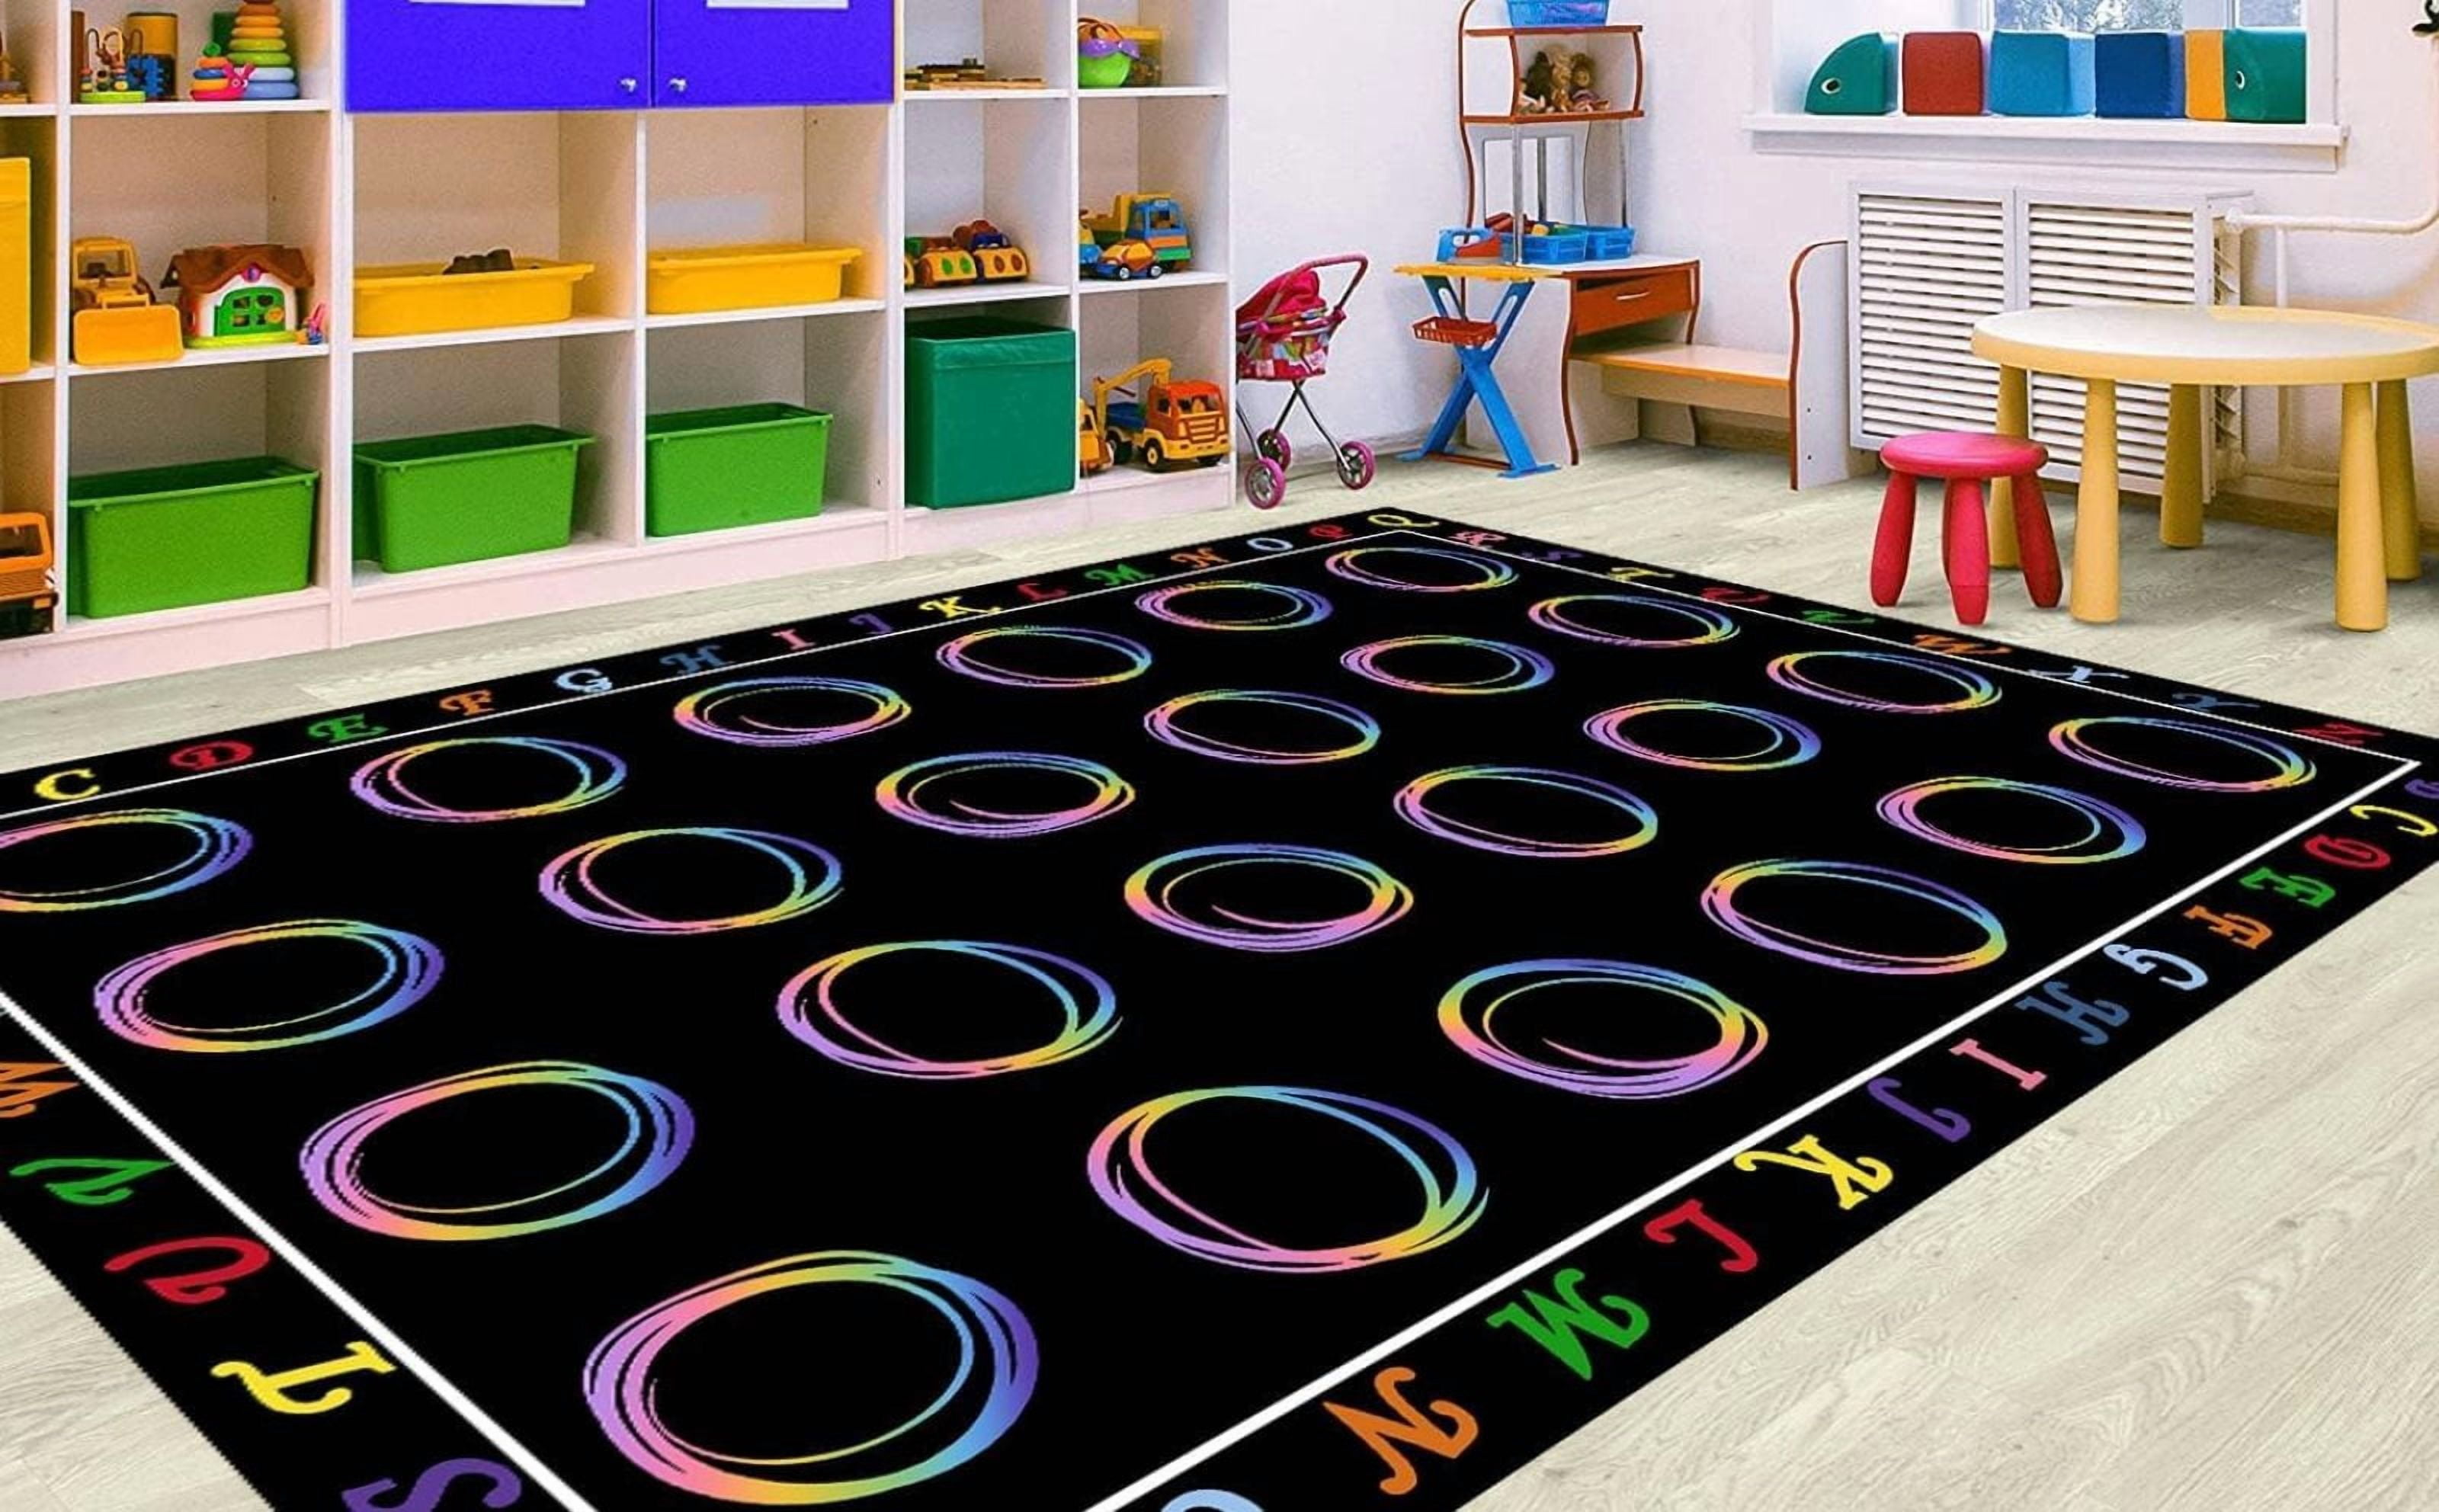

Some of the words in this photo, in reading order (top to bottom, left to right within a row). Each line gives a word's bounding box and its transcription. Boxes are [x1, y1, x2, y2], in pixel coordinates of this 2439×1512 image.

[34, 768, 101, 800] C
[170, 741, 253, 770] D
[309, 714, 386, 742] E
[440, 690, 494, 716] F
[555, 668, 613, 693] G
[659, 645, 736, 675] H
[772, 629, 814, 649] I
[918, 596, 1002, 618] K
[1247, 537, 1293, 551] O
[2304, 834, 2390, 868] D
[2349, 805, 2438, 837] C
[2240, 867, 2335, 907] E
[2184, 905, 2273, 949] F
[2103, 944, 2209, 991] G
[2015, 982, 2129, 1045] H
[1949, 1038, 2046, 1091] I
[1867, 1078, 1970, 1142] J
[1733, 1135, 1894, 1210] K
[1644, 1199, 1758, 1272] L
[104, 1236, 270, 1305] U
[1486, 1268, 1649, 1380] M
[210, 1341, 396, 1414] T
[1323, 1366, 1479, 1495] N
